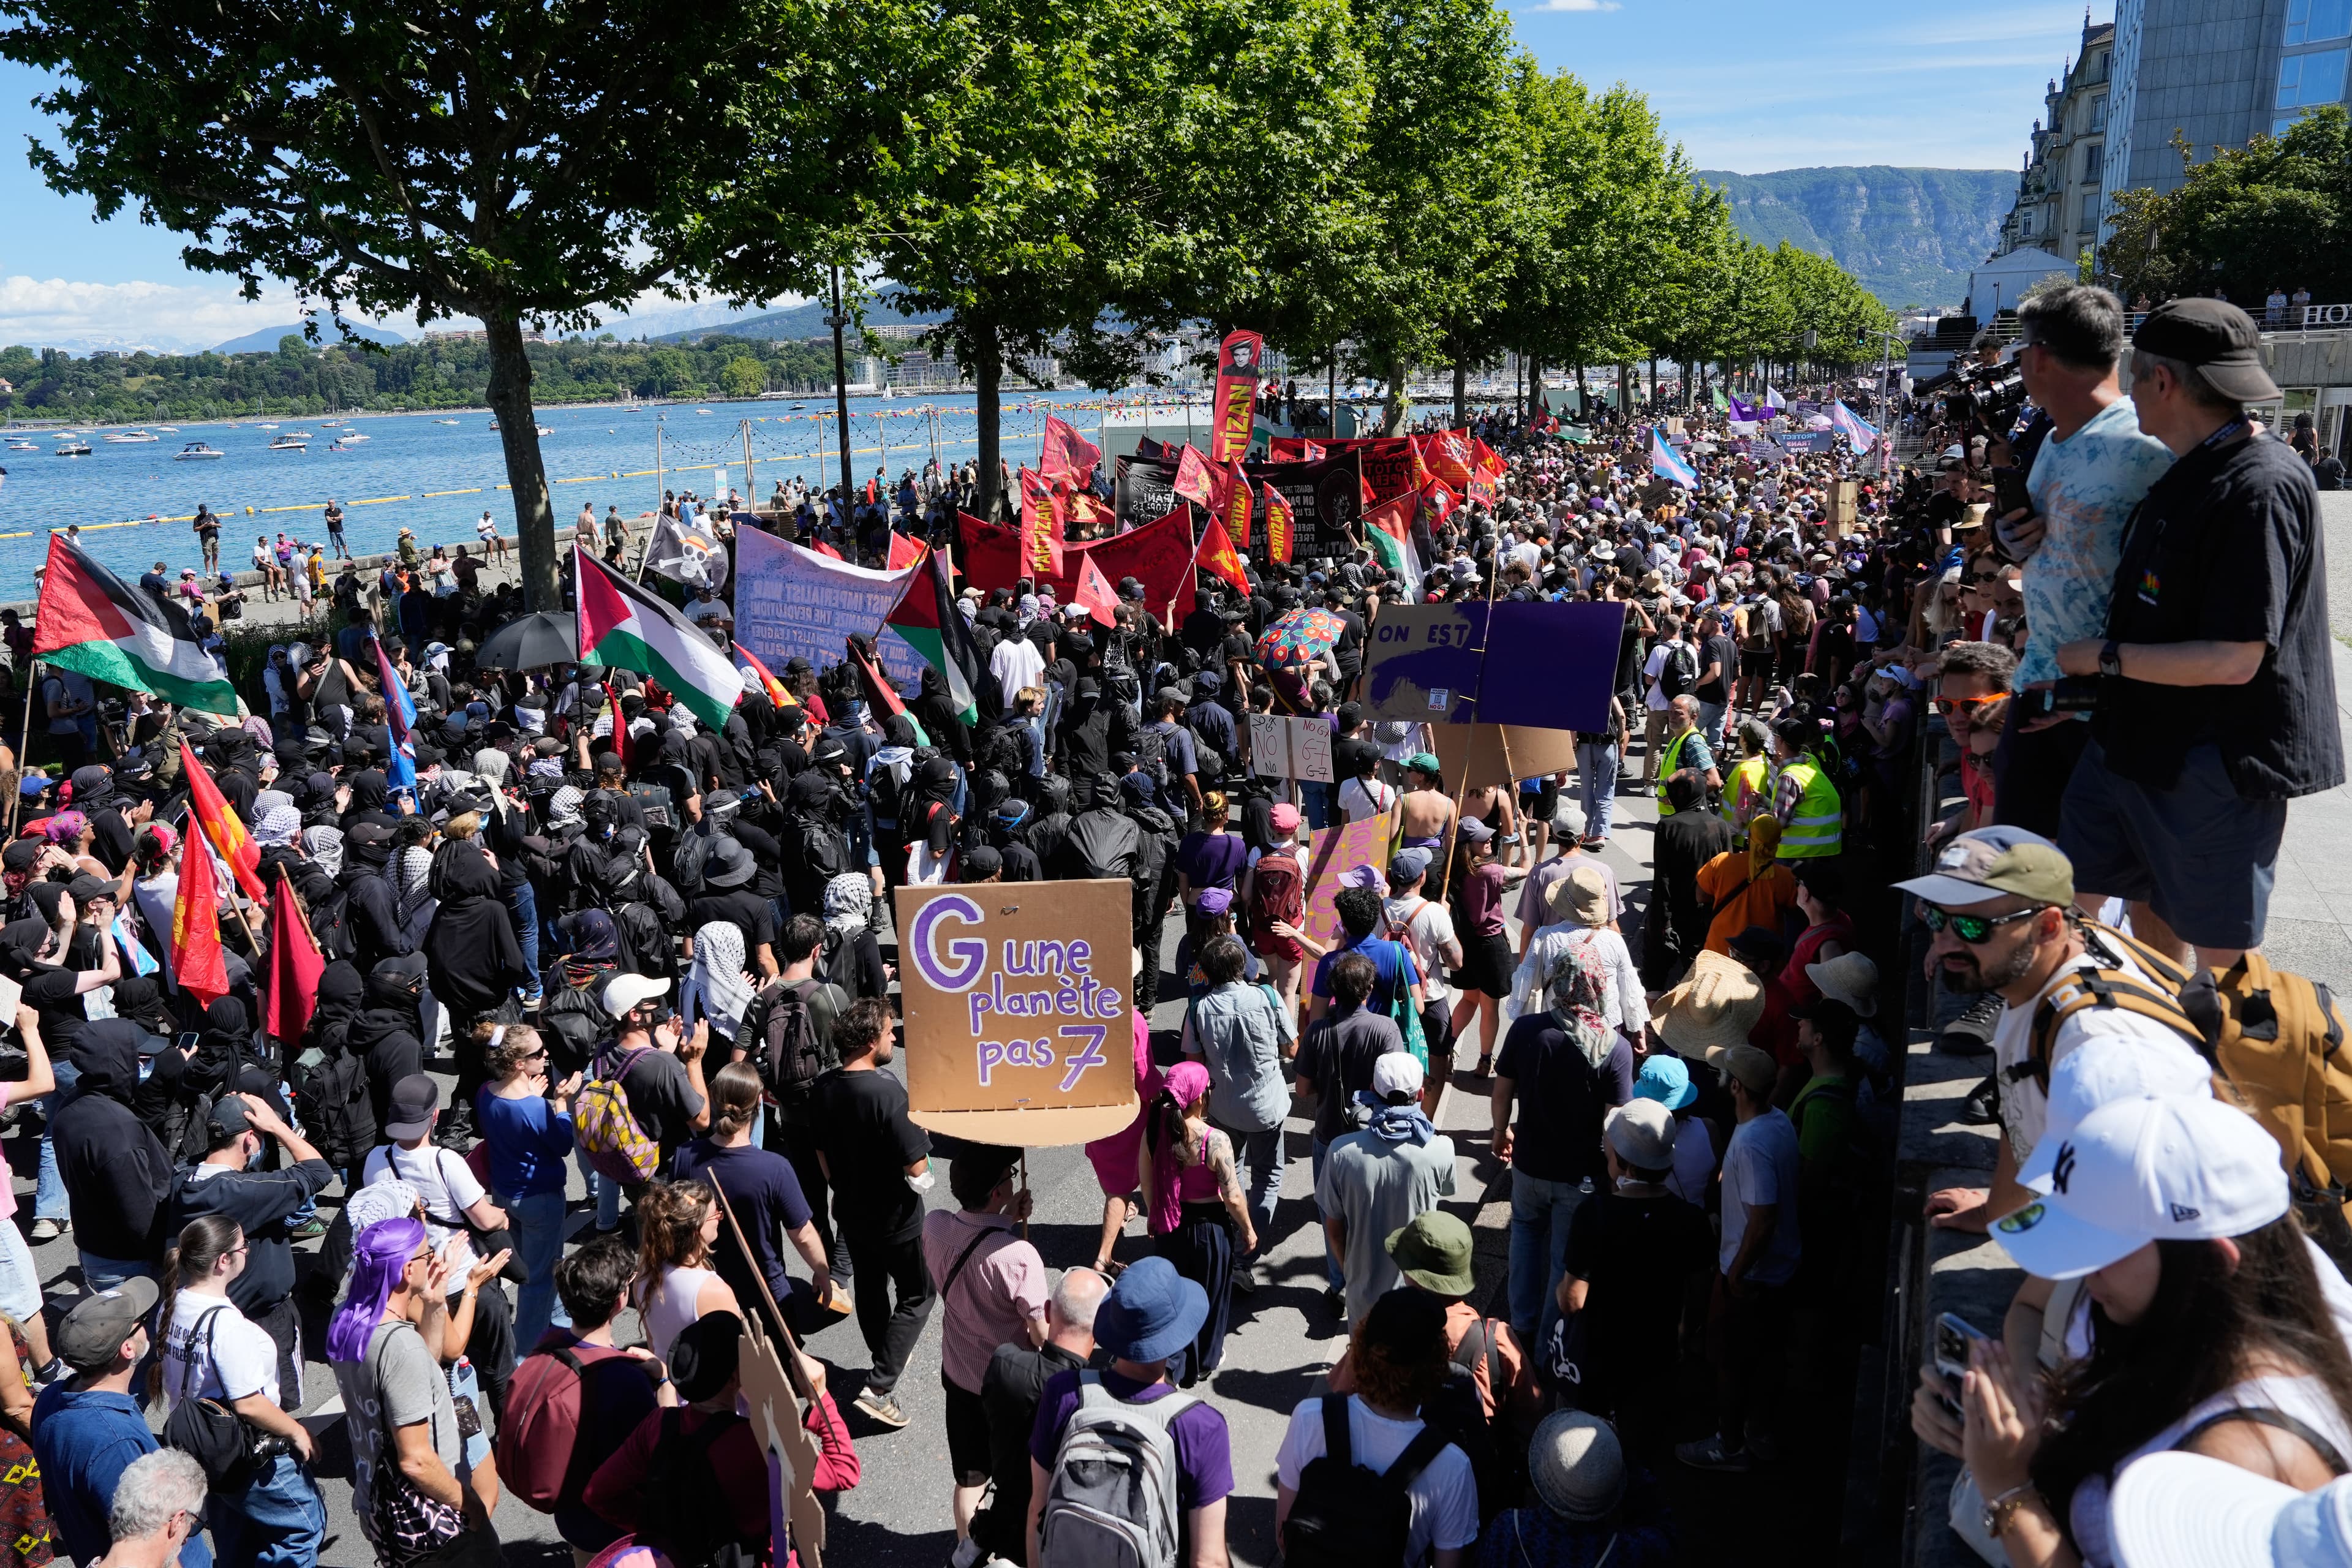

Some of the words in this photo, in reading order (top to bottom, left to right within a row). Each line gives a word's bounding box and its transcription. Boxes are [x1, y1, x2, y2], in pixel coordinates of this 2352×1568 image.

[1378, 625, 1410, 643] ON
[1427, 624, 1469, 646] EST
[1303, 719, 1316, 732] NO
[1256, 731, 1277, 760] NO
[1302, 738, 1330, 766] G7
[910, 892, 988, 993] G
[1001, 938, 1093, 978] une
[968, 970, 1125, 1036] planète
[978, 1036, 1055, 1087] pas
[1058, 1024, 1107, 1093] 7
